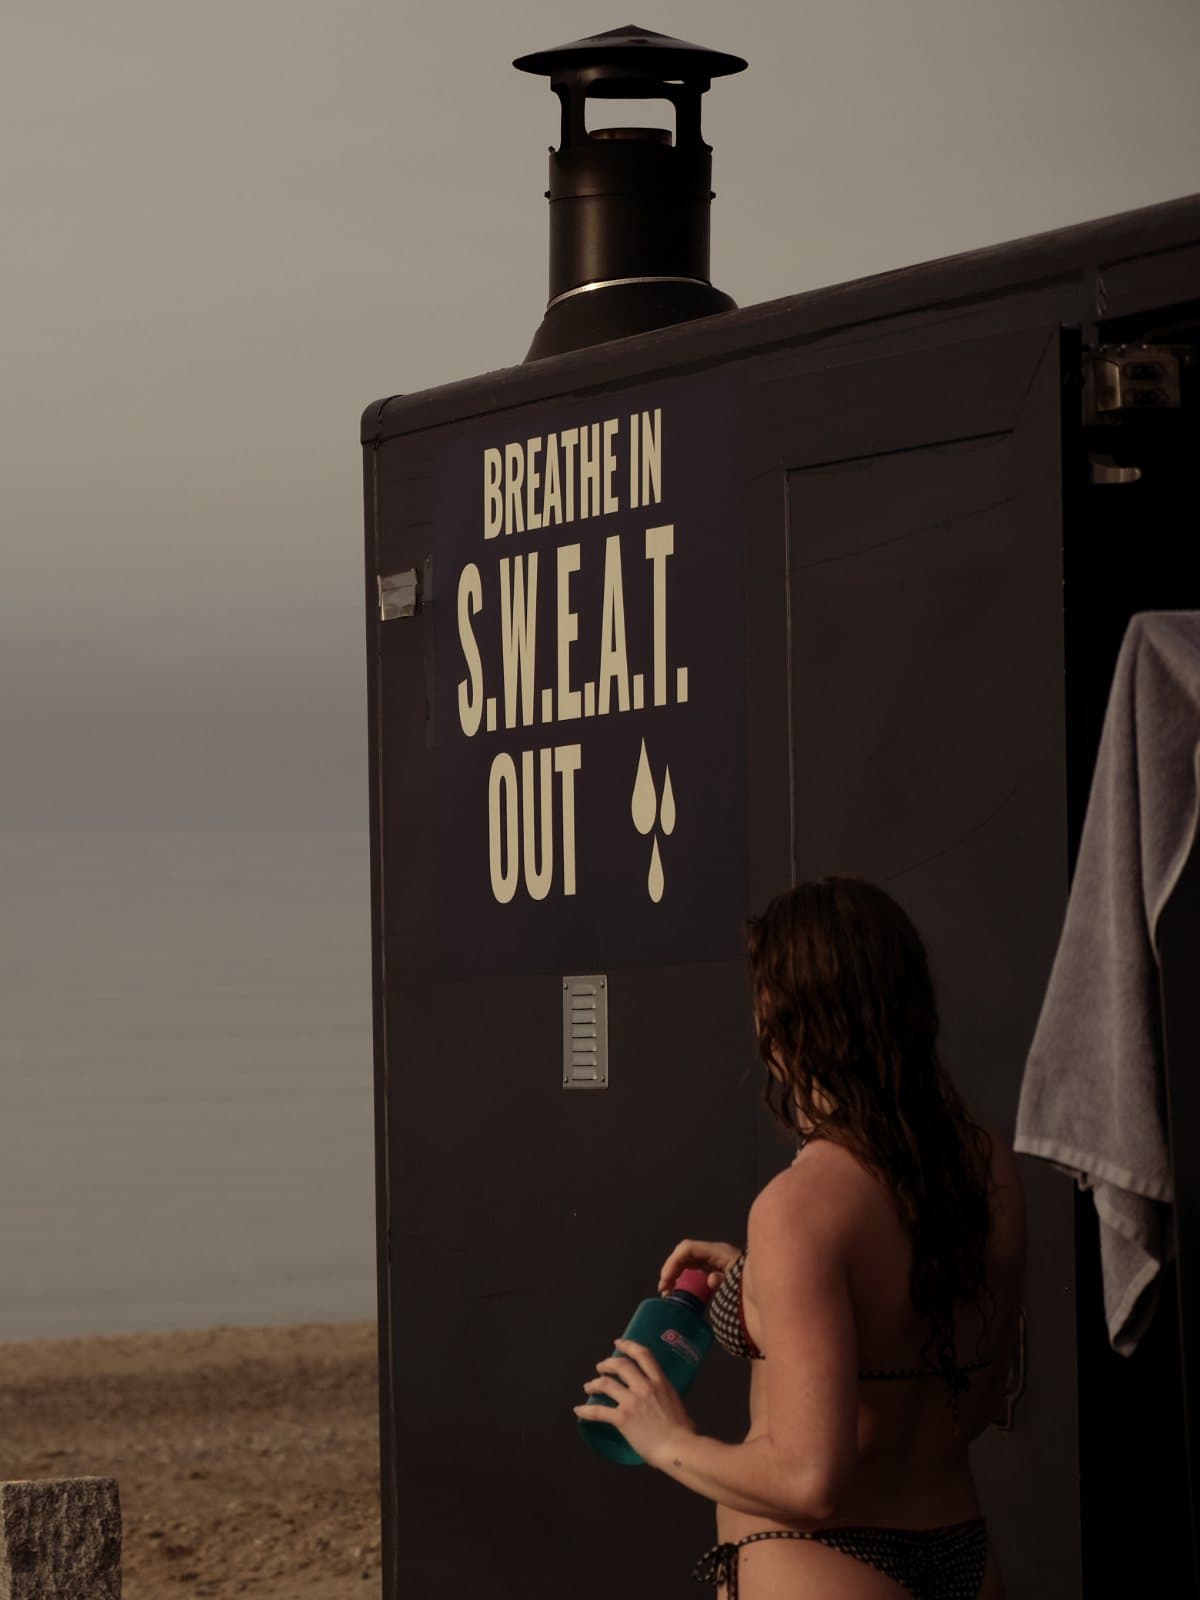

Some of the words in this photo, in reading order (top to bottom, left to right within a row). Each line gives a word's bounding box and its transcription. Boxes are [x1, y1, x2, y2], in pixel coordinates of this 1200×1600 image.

[483, 418, 620, 541] BREATHE
[629, 407, 662, 510] IN
[456, 523, 689, 738] S.W.E.A.T.
[487, 742, 583, 905] OUT
